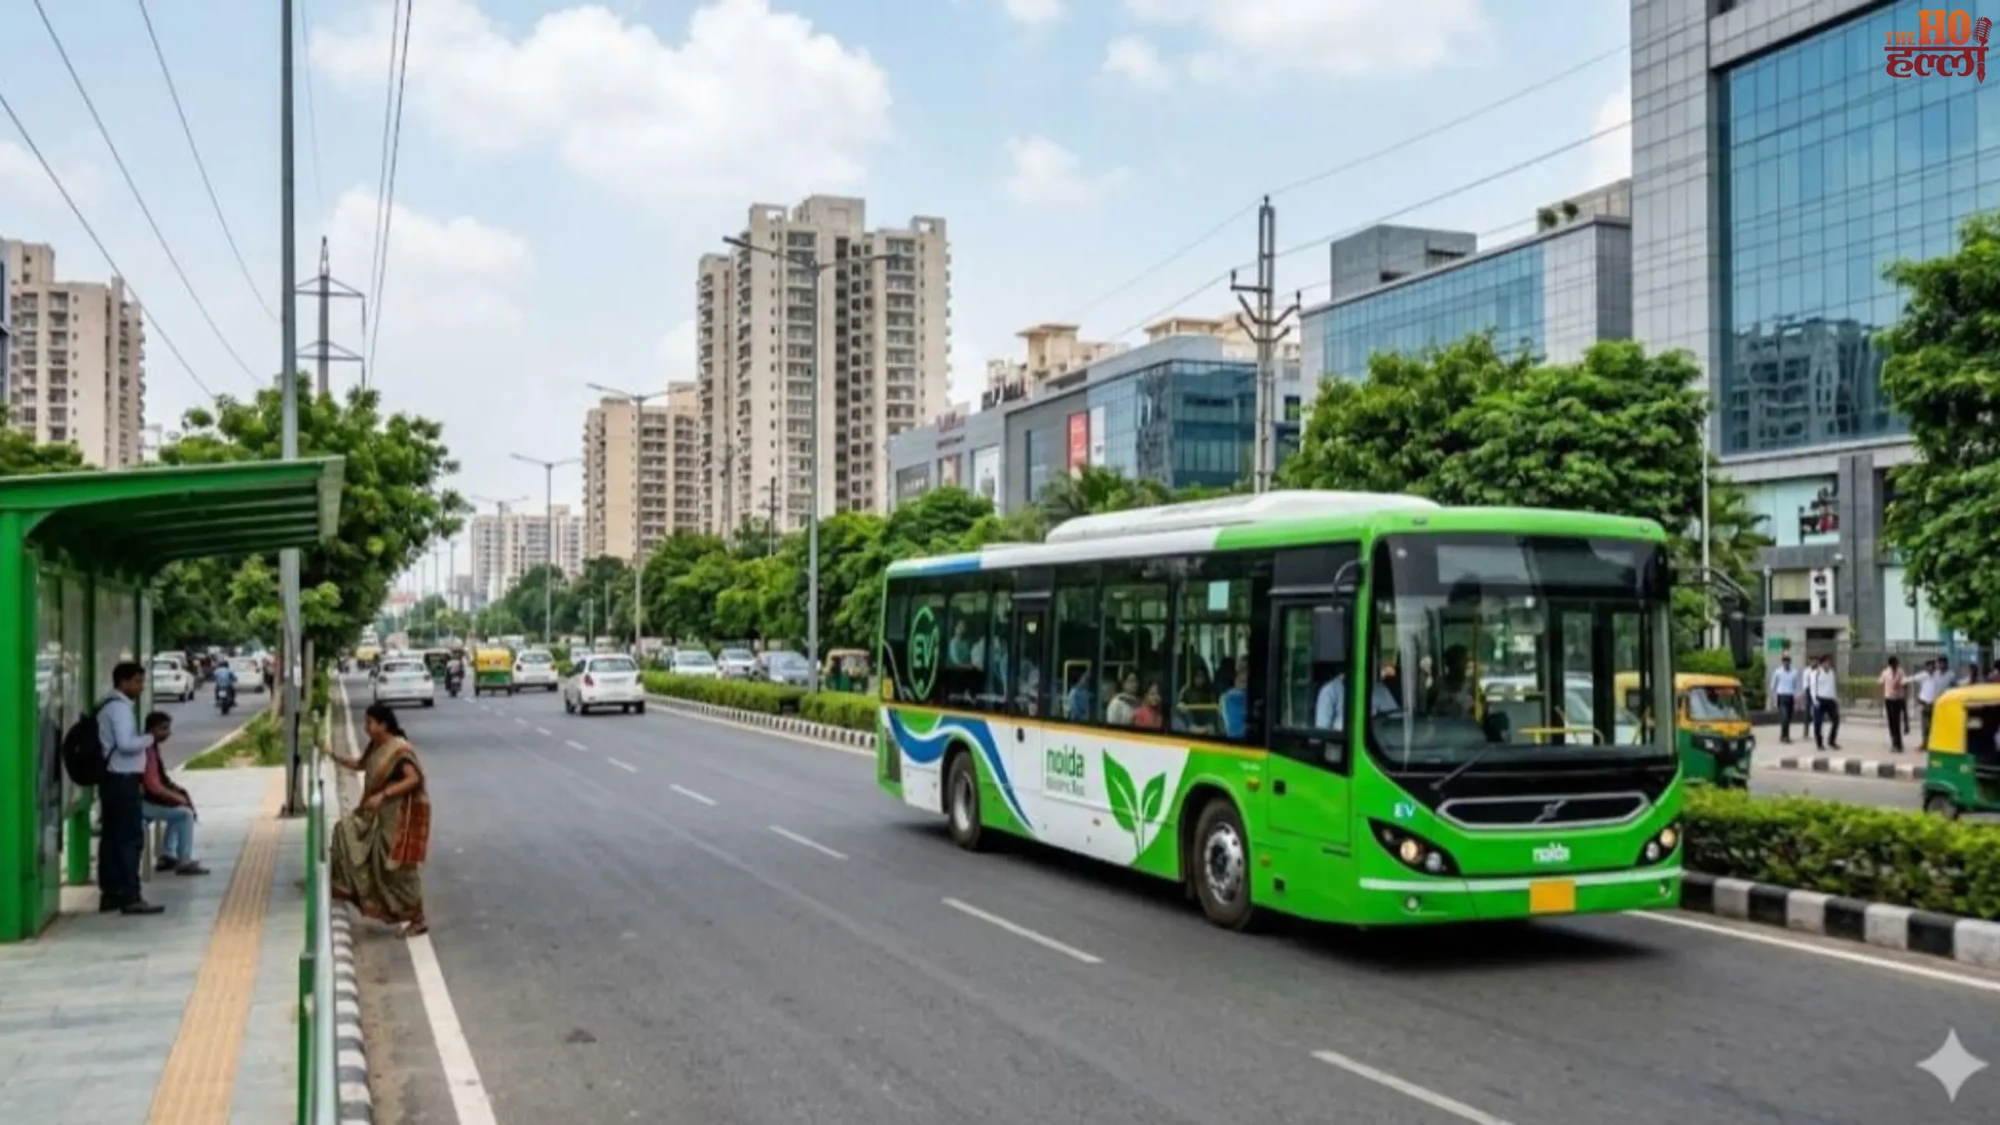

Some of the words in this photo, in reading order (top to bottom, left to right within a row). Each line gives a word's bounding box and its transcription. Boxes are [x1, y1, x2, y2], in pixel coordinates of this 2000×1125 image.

[913, 633, 934, 668] EV
[1046, 743, 1085, 778] noida
[1393, 802, 1416, 818] EV
